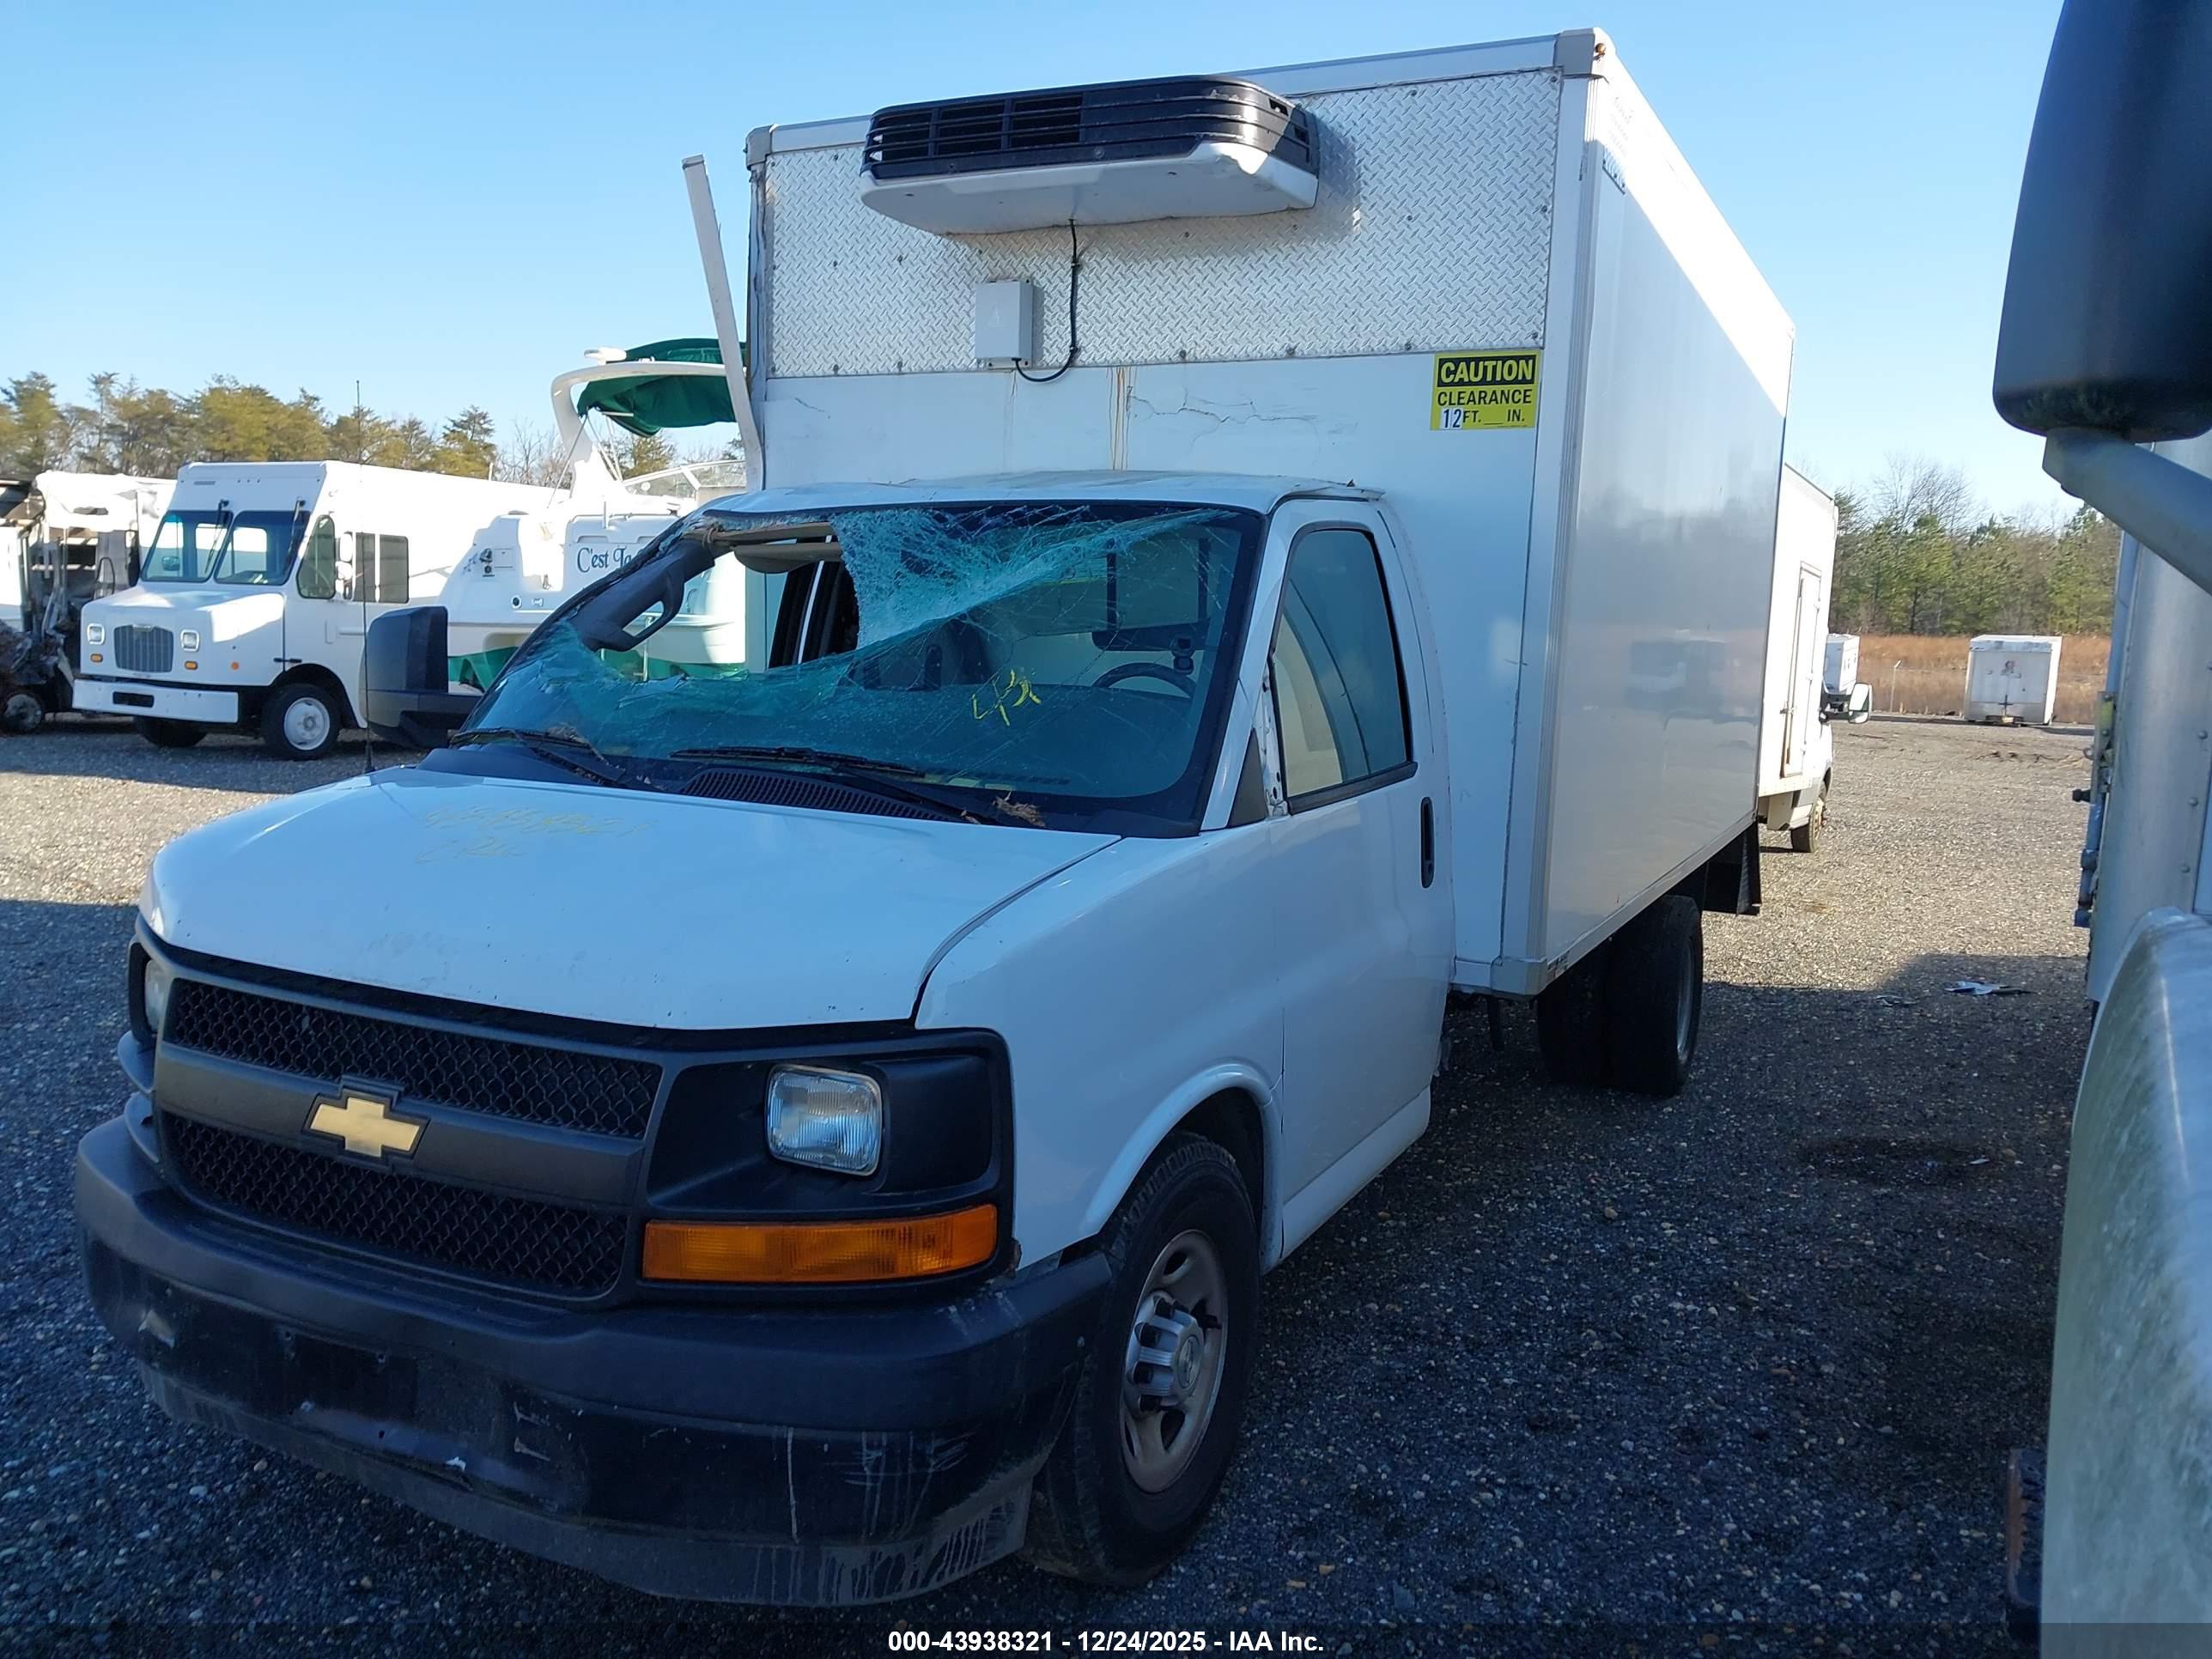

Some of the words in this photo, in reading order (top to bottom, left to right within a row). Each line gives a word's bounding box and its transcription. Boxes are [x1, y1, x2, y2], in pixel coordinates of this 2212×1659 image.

[1440, 359, 1534, 384] CAUTION
[1437, 388, 1533, 407] CLEARANCE
[1506, 409, 1526, 422] IN.
[577, 547, 610, 574] C'est
